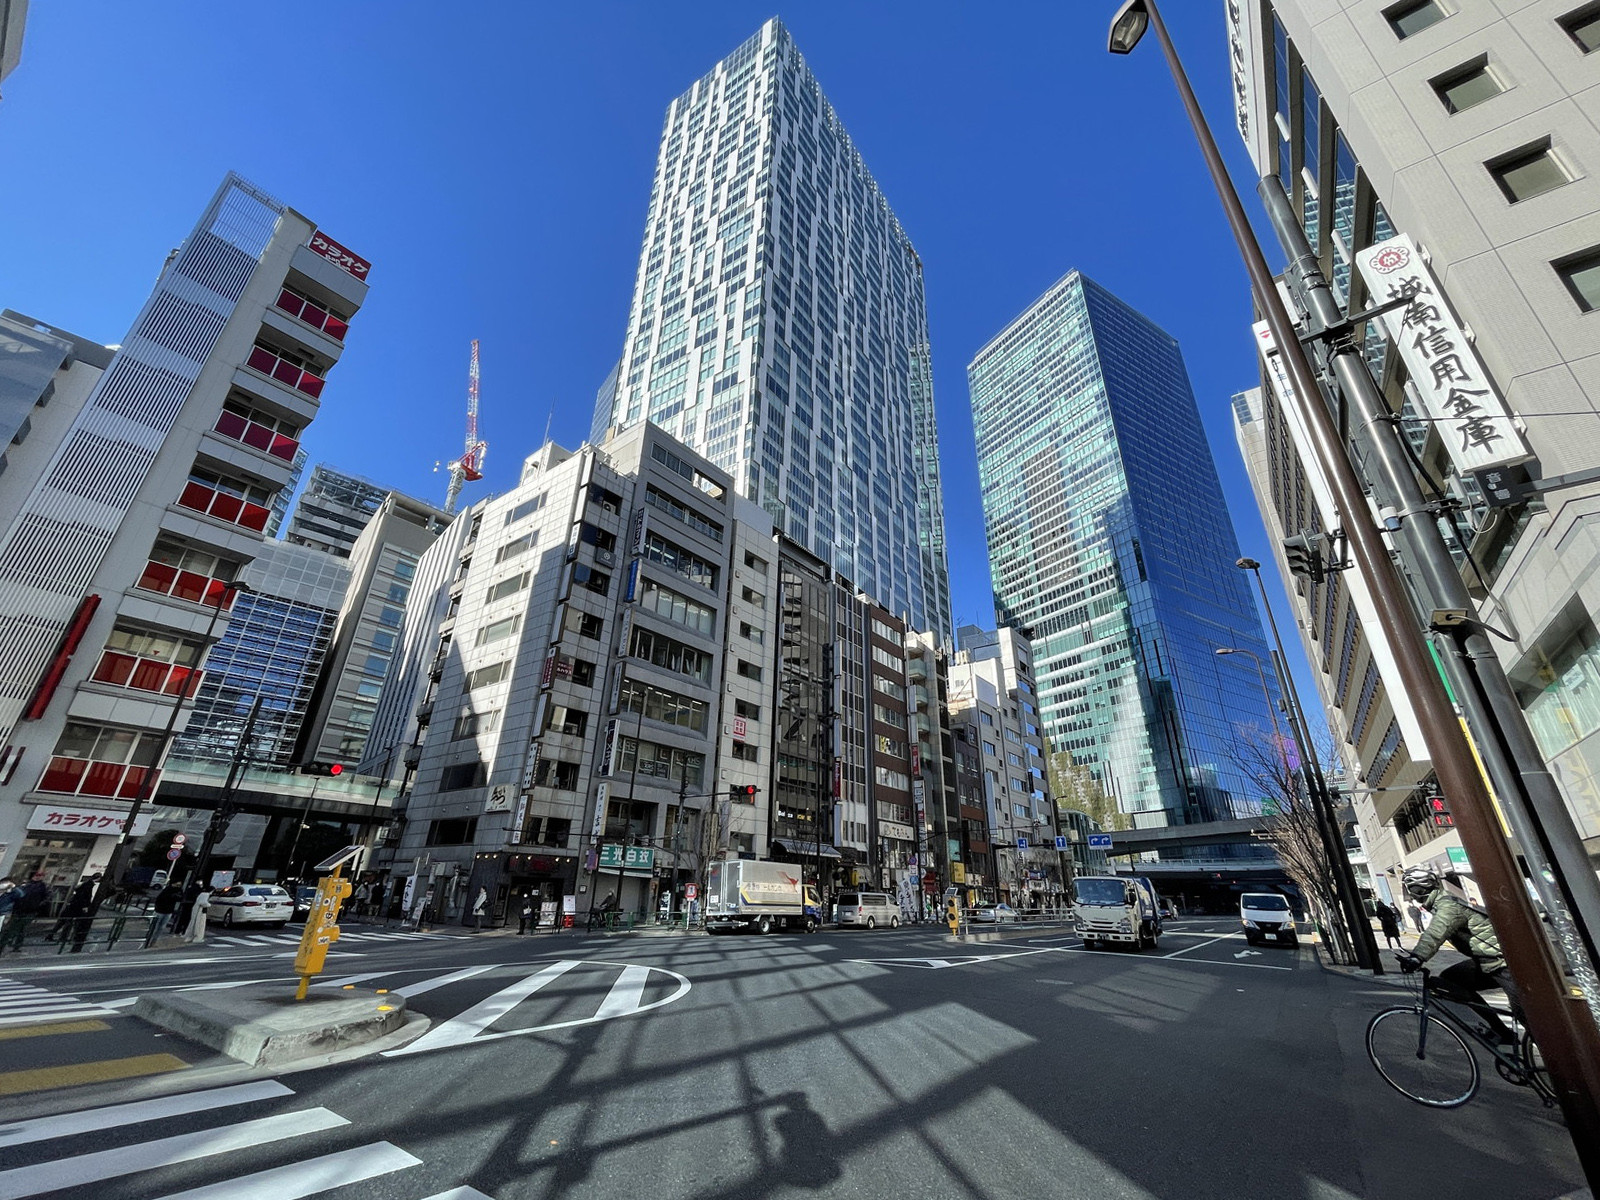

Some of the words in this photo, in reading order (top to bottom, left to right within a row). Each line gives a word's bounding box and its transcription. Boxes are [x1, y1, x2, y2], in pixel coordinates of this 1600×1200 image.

[313, 237, 368, 273] カラオケ
[1387, 276, 1503, 454] 城南信用金庫
[44, 812, 114, 828] カラオケ
